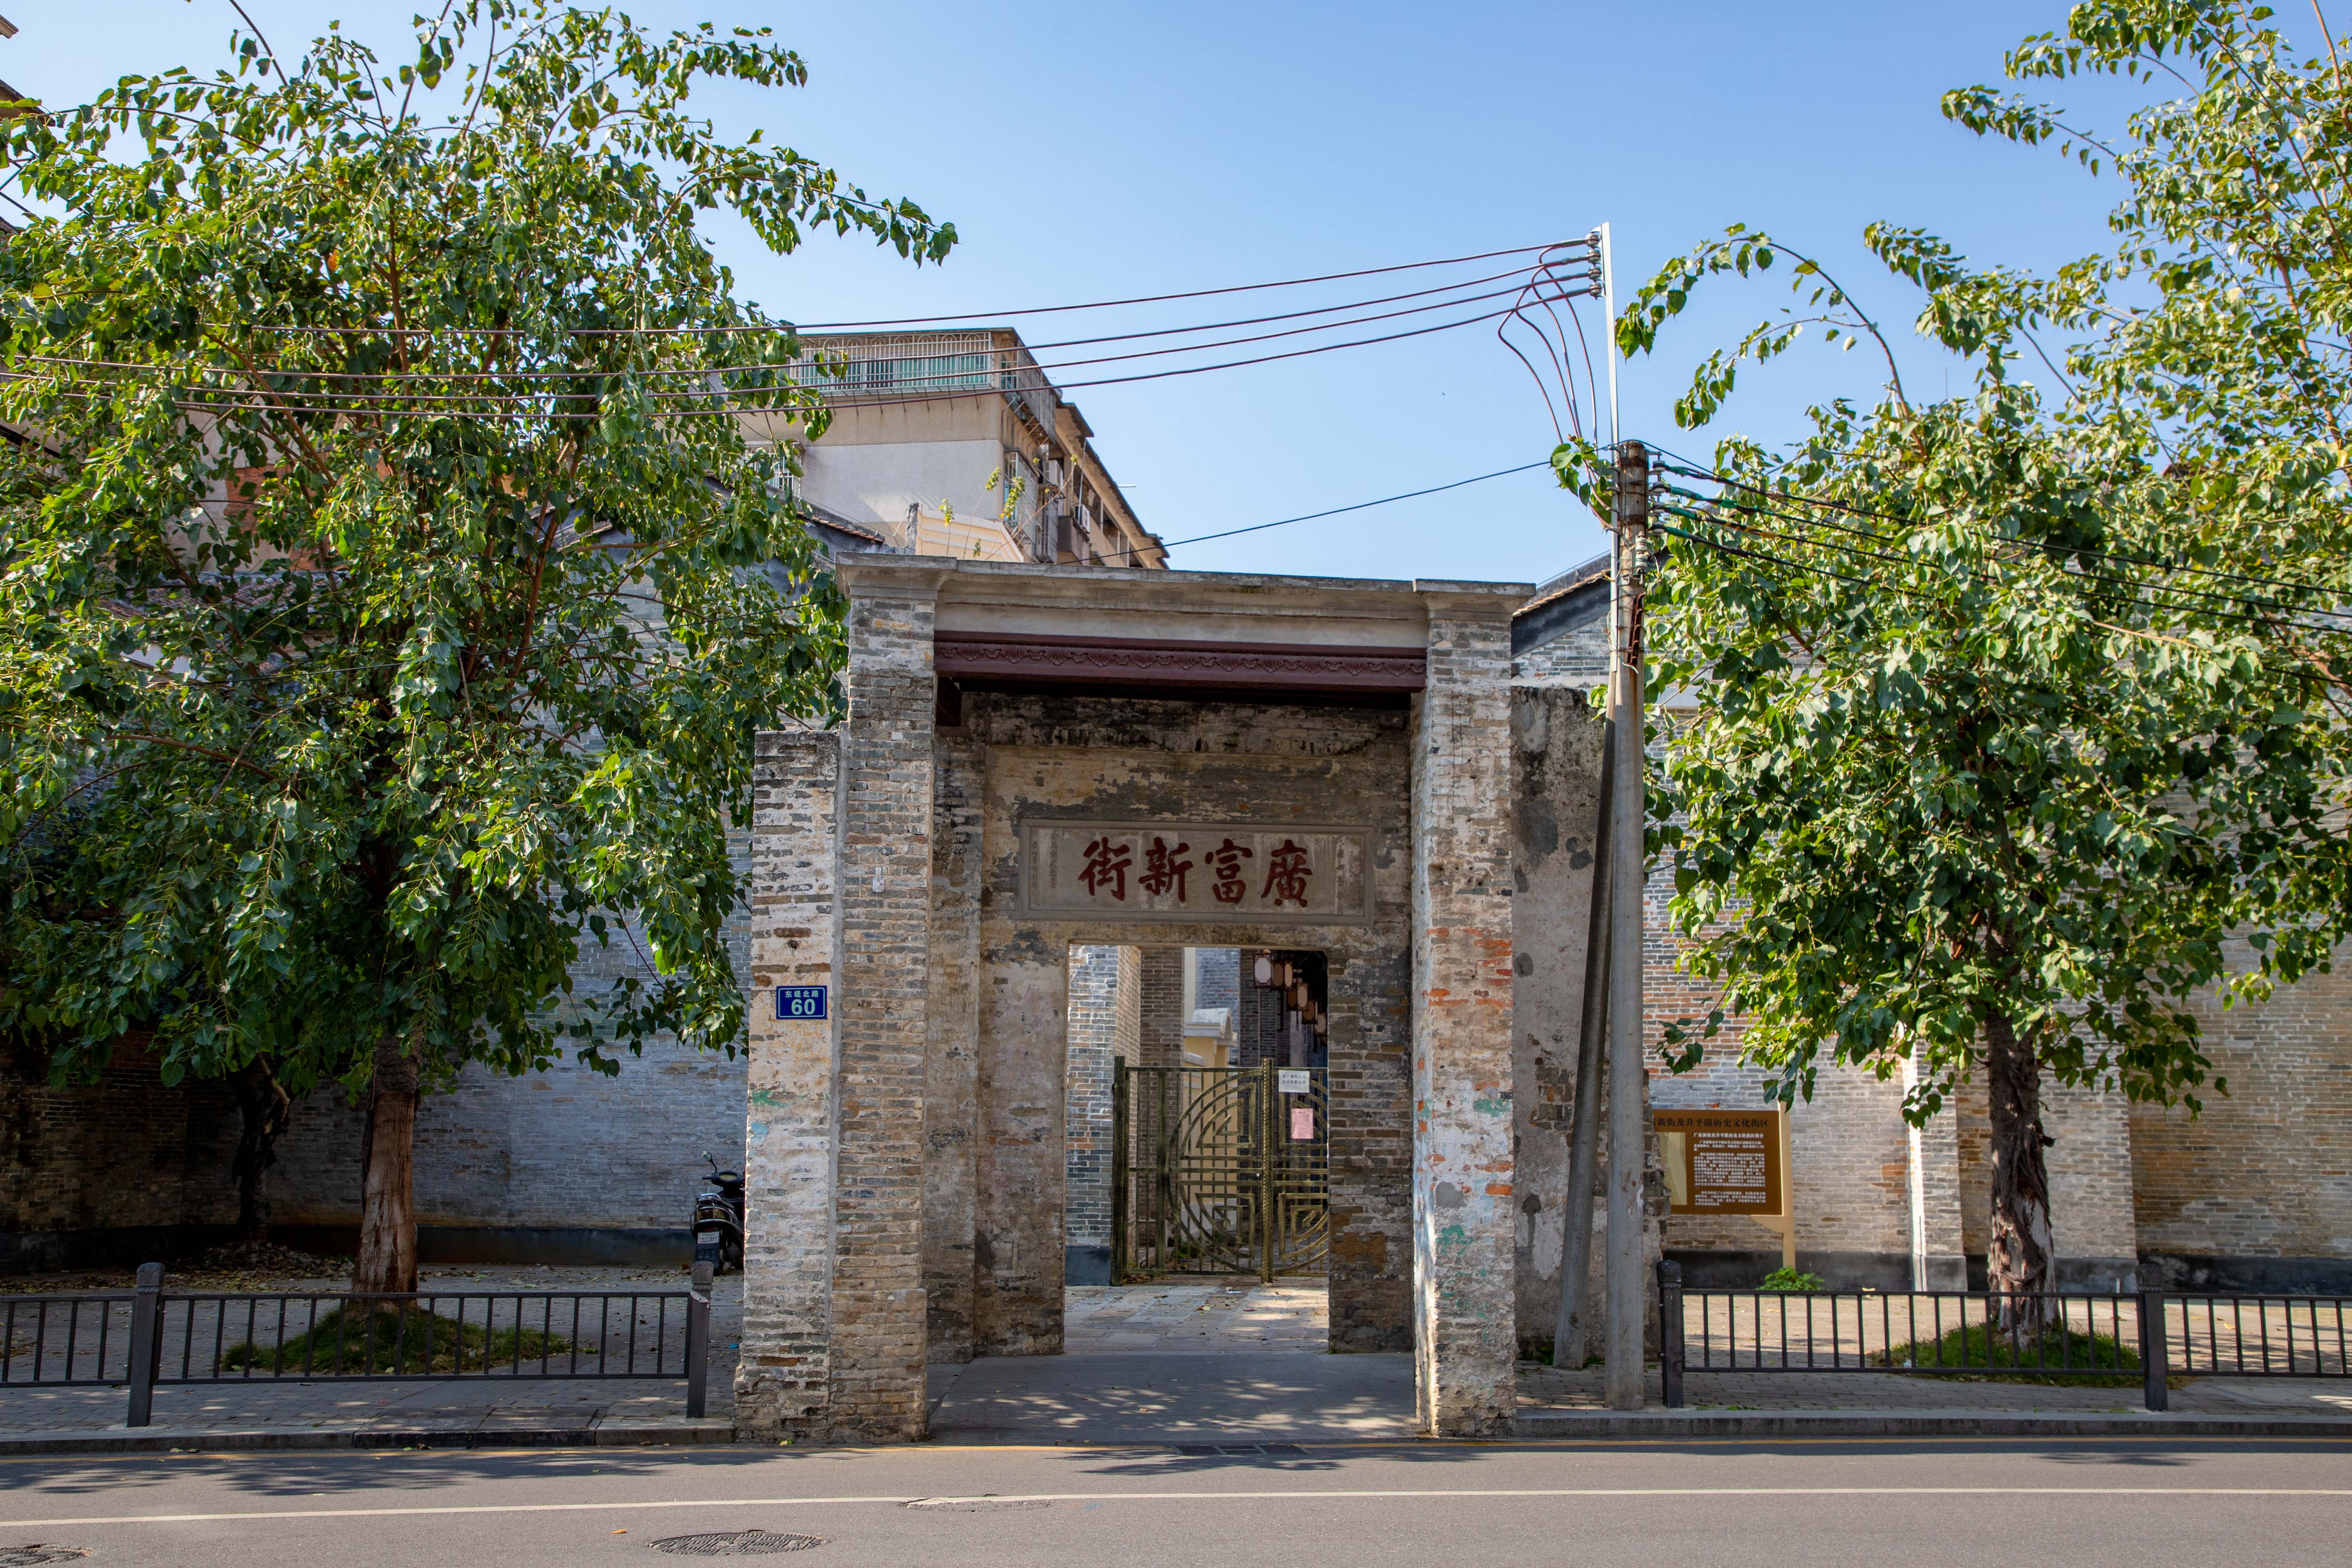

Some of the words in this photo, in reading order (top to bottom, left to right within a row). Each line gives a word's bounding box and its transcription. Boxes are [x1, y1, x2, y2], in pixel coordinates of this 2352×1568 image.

[1078, 836, 1312, 908] 廣富新街
[791, 999, 816, 1015] 60
